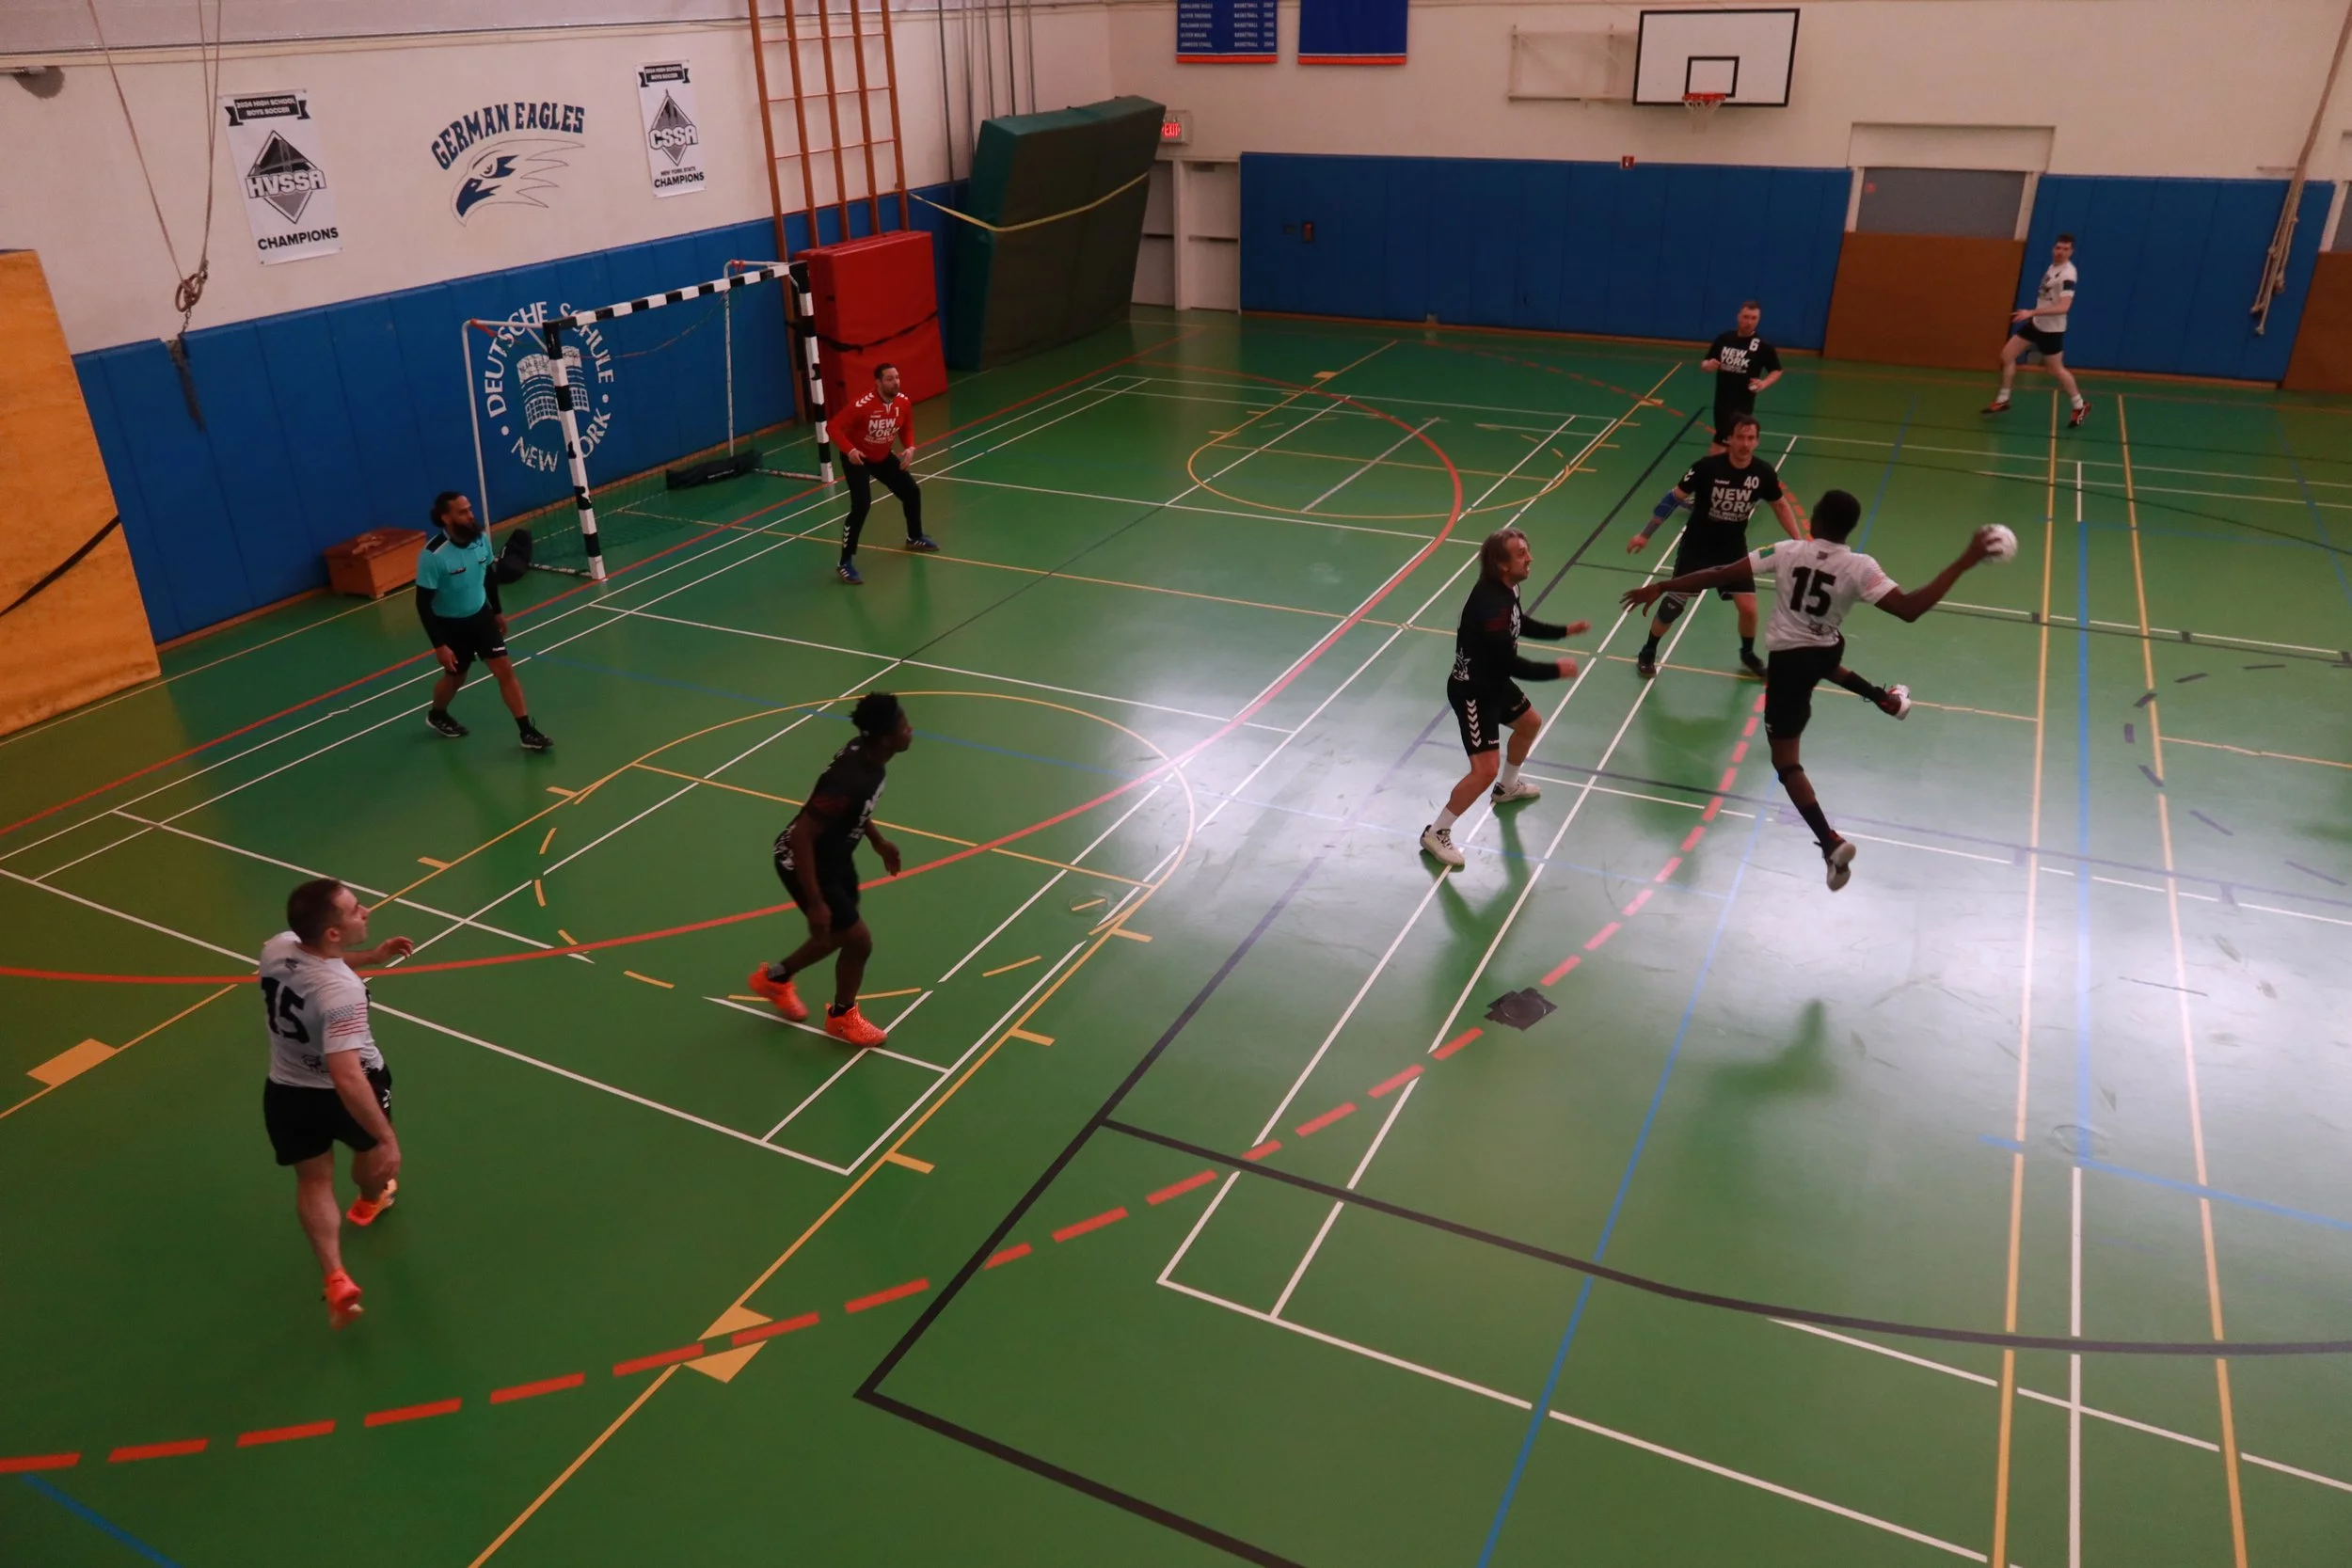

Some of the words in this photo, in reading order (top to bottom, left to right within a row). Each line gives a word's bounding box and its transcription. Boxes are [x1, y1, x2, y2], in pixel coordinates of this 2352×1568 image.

[431, 103, 510, 170] GERMAN
[514, 102, 585, 134] EAGLES
[649, 124, 698, 150] CSSA
[1164, 122, 1178, 136] EXIT
[246, 169, 326, 198] HVSSA
[654, 171, 705, 188] CHAMPIONS
[258, 227, 339, 250] CHAMPIONS
[1722, 346, 1748, 358] NEW
[1749, 338, 1760, 352] 6
[485, 301, 549, 419] DEUTSCHE
[1721, 356, 1751, 368] YORK
[895, 406, 899, 417] 1
[869, 418, 896, 429] NEW
[511, 436, 559, 472] NEW
[578, 407, 612, 458] ORK
[1743, 476, 1759, 489] 40
[1711, 486, 1752, 501] NEW
[1789, 566, 1836, 617] 15
[261, 976, 310, 1044] 15
